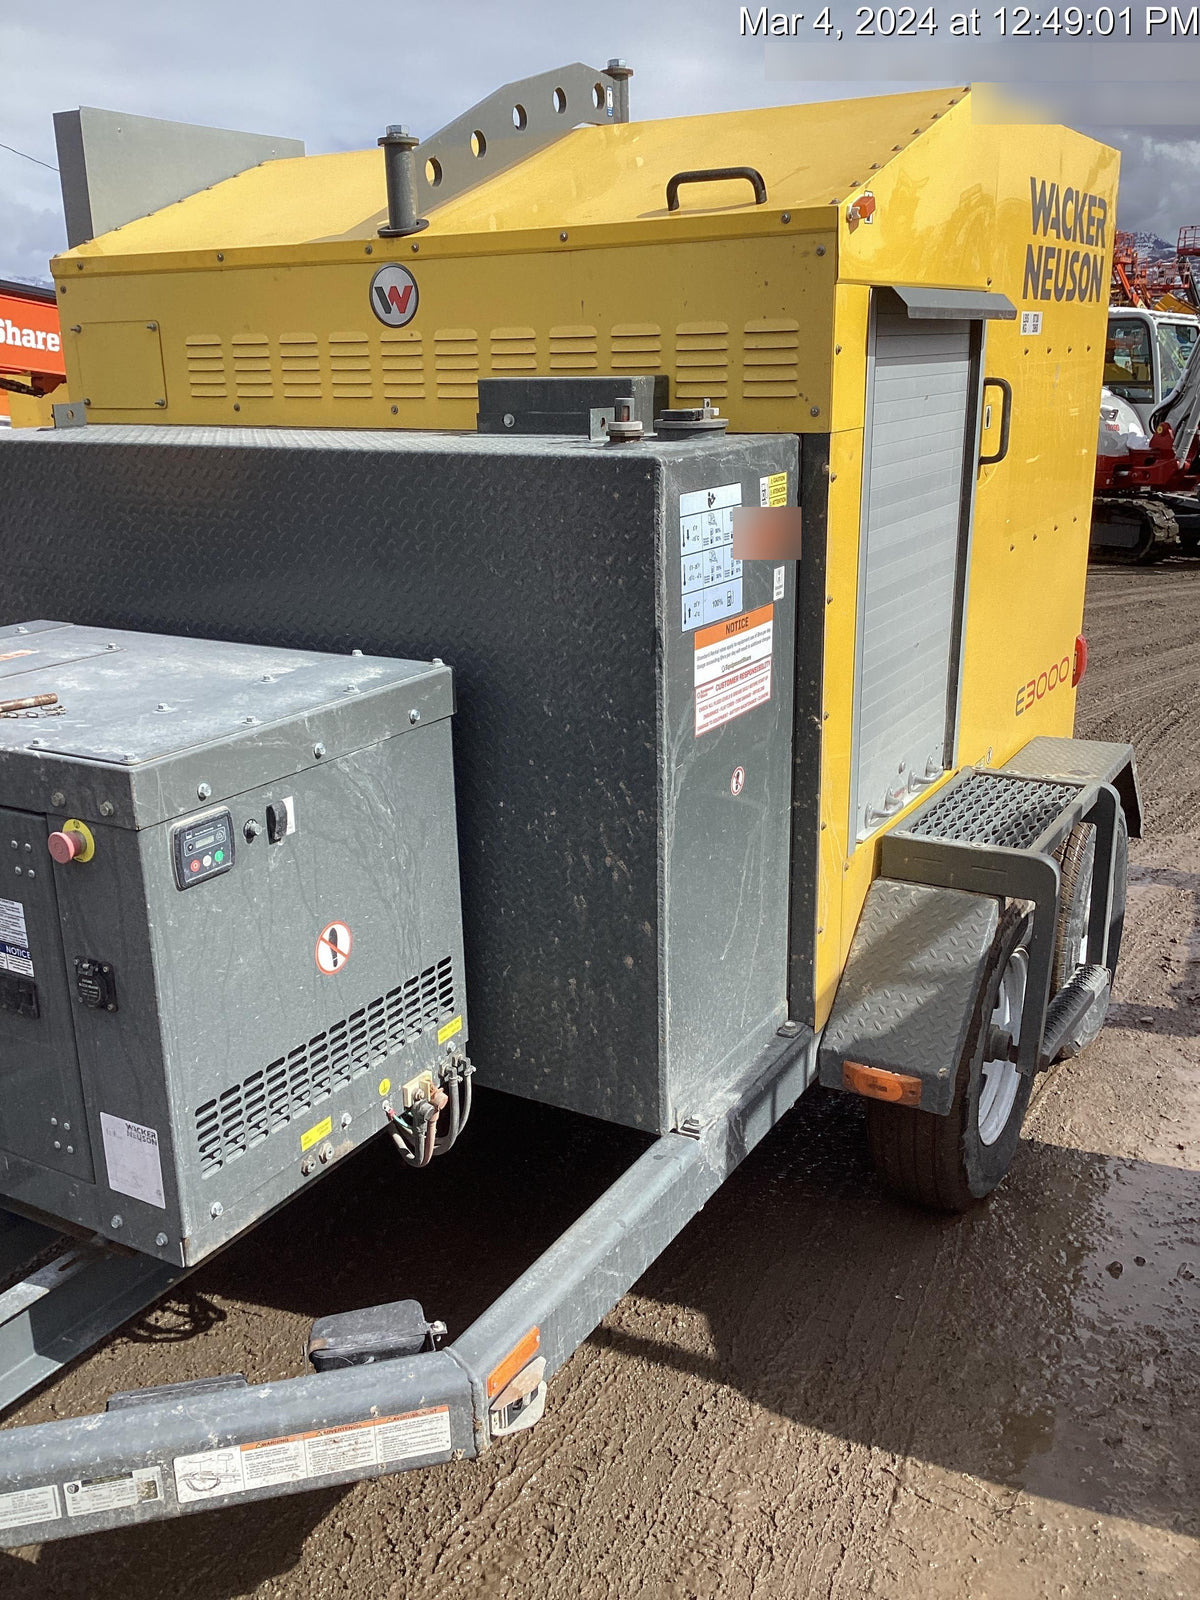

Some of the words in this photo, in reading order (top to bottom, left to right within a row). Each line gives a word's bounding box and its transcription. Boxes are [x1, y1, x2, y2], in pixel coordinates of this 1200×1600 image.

[1030, 177, 1107, 248] WACKER
[1022, 244, 1105, 303] NEUSON
[725, 616, 749, 635] NOTICE
[715, 675, 739, 691] CUSTOMER
[740, 660, 771, 680] RESPONSIBILITY
[1015, 656, 1070, 717] E3000
[5, 945, 31, 959] NOTICE
[125, 1122, 157, 1139] WACKER
[126, 1130, 158, 1146] NEUSON
[261, 1437, 290, 1448] WARNING
